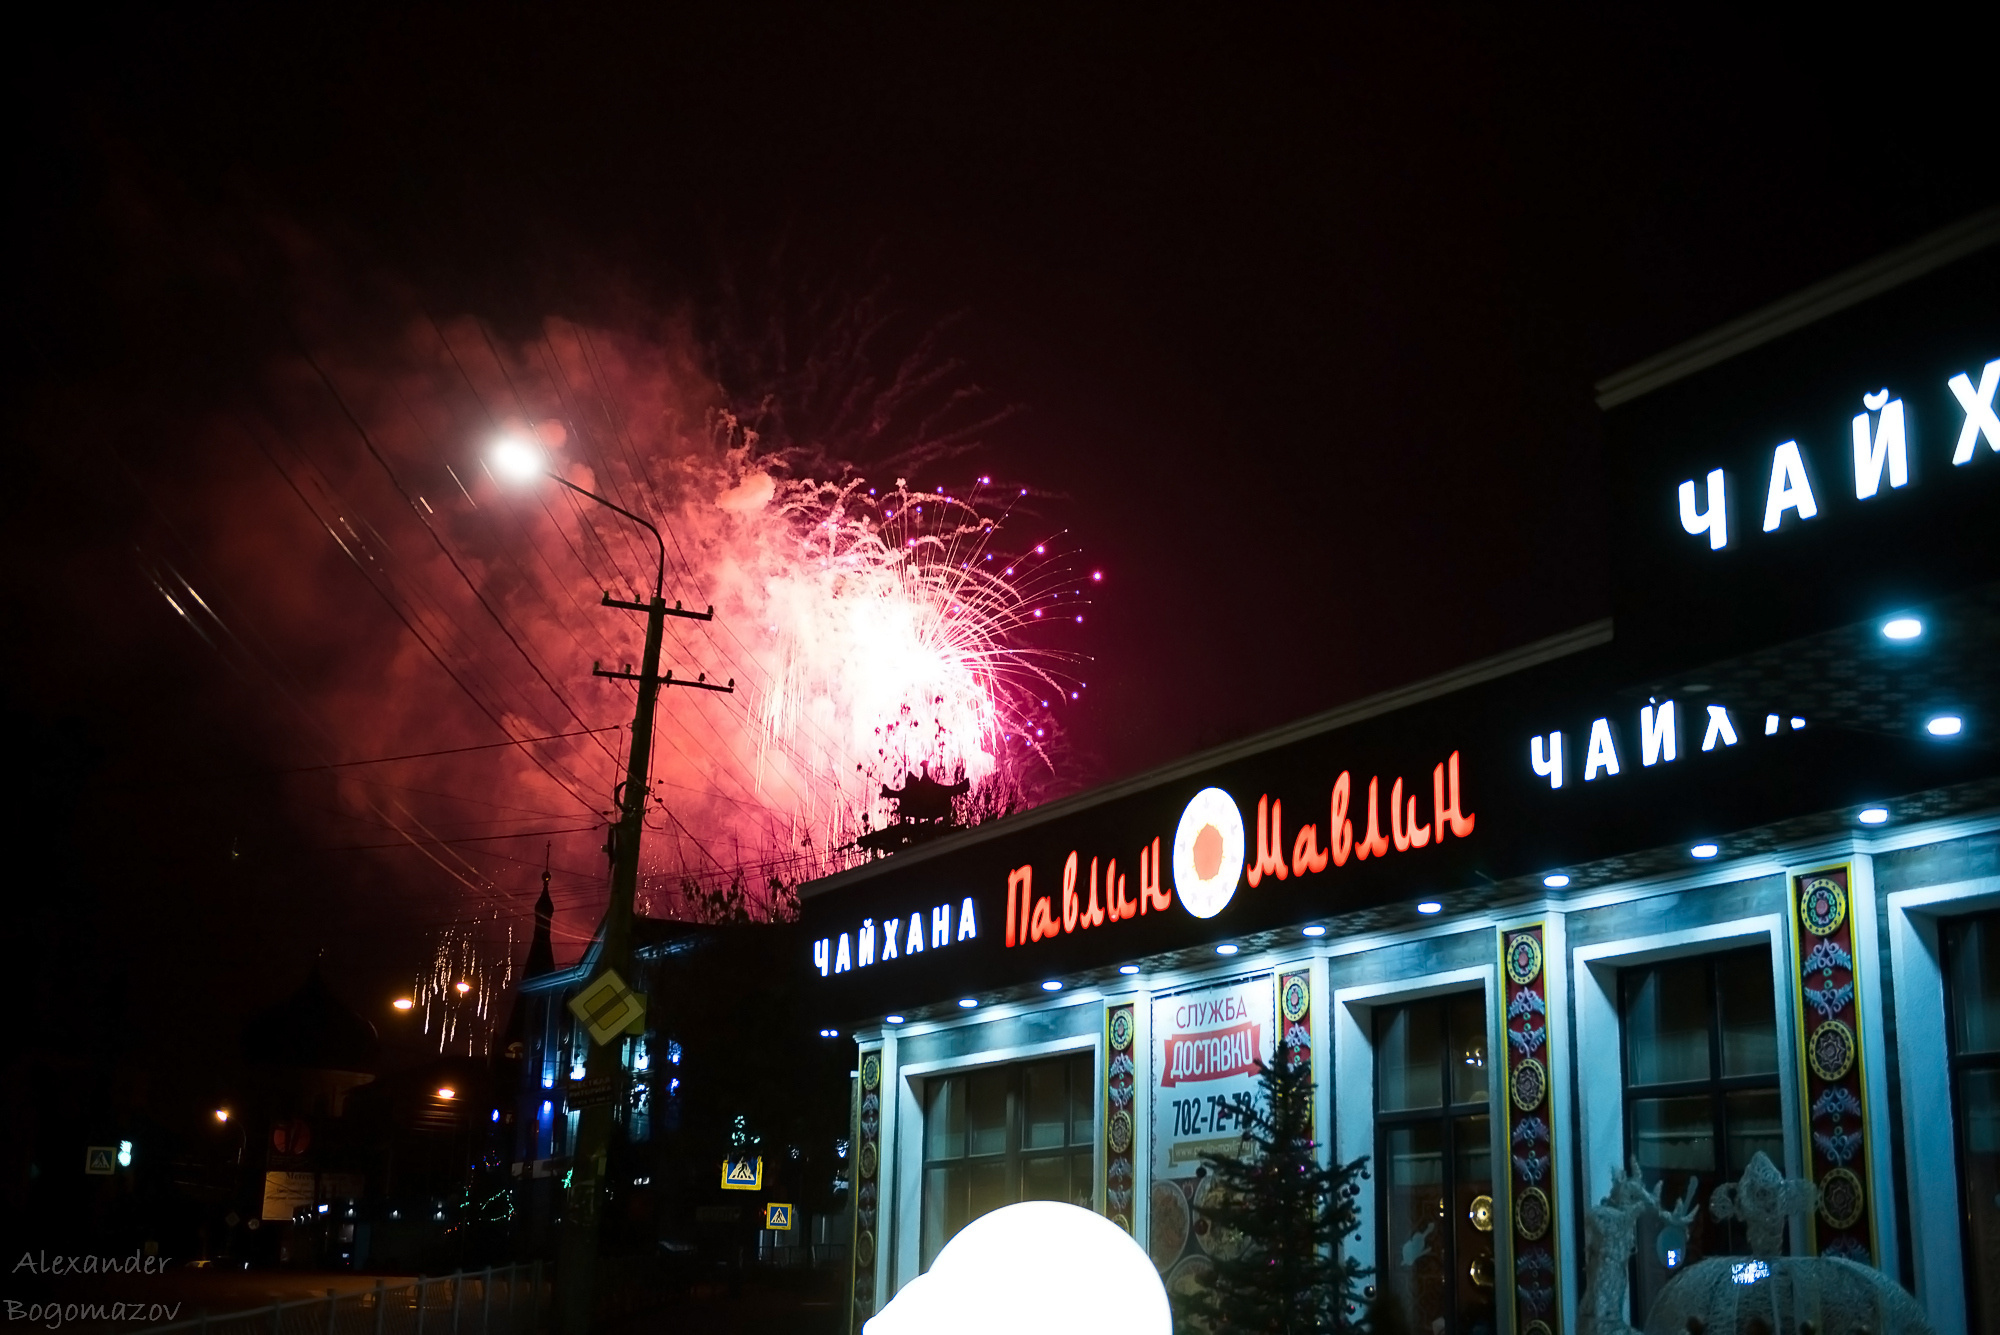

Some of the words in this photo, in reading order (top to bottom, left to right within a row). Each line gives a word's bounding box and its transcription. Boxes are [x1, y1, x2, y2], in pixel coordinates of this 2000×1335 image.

[1530, 697, 1806, 789] ЧАЙХ
[1005, 836, 1172, 948] Павлин
[1246, 750, 1476, 889] Мавлин
[814, 897, 977, 977] ЧАЙХАНА
[1176, 995, 1247, 1029] СЛУЖБА
[1170, 1028, 1253, 1079] ДОСТАВКИ
